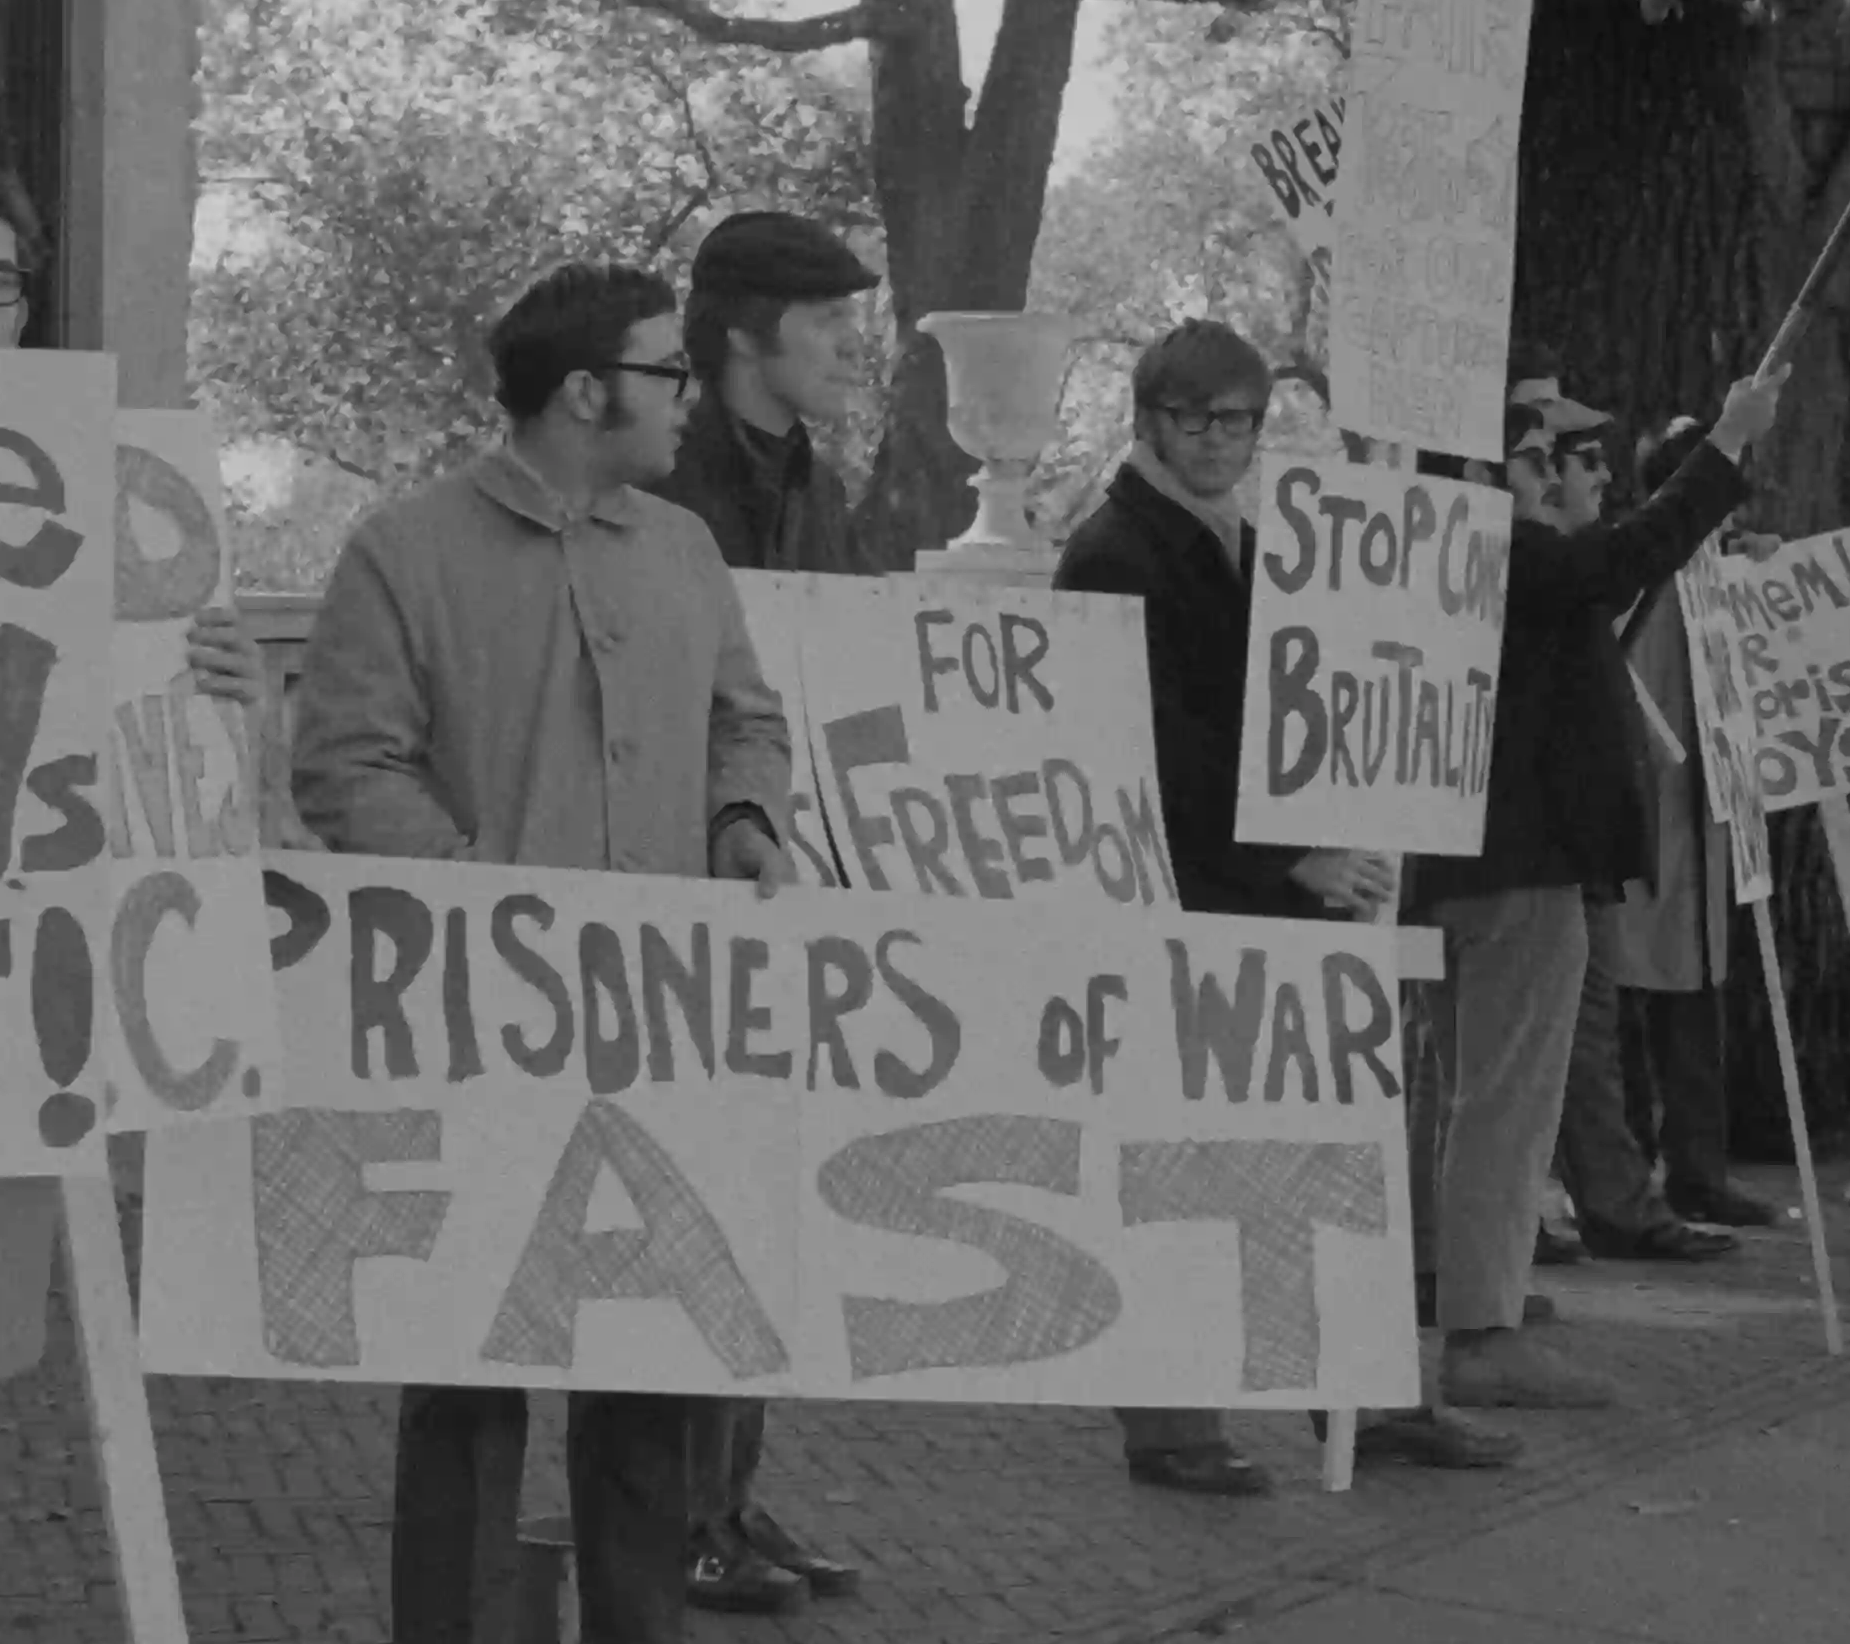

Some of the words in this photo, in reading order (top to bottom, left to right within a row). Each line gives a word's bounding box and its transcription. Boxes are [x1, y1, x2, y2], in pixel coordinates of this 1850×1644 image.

[1262, 466, 1437, 595] STOP
[913, 608, 1056, 715] FOR
[1165, 938, 1401, 1105] WAR
[250, 1099, 1387, 1391] FAST
